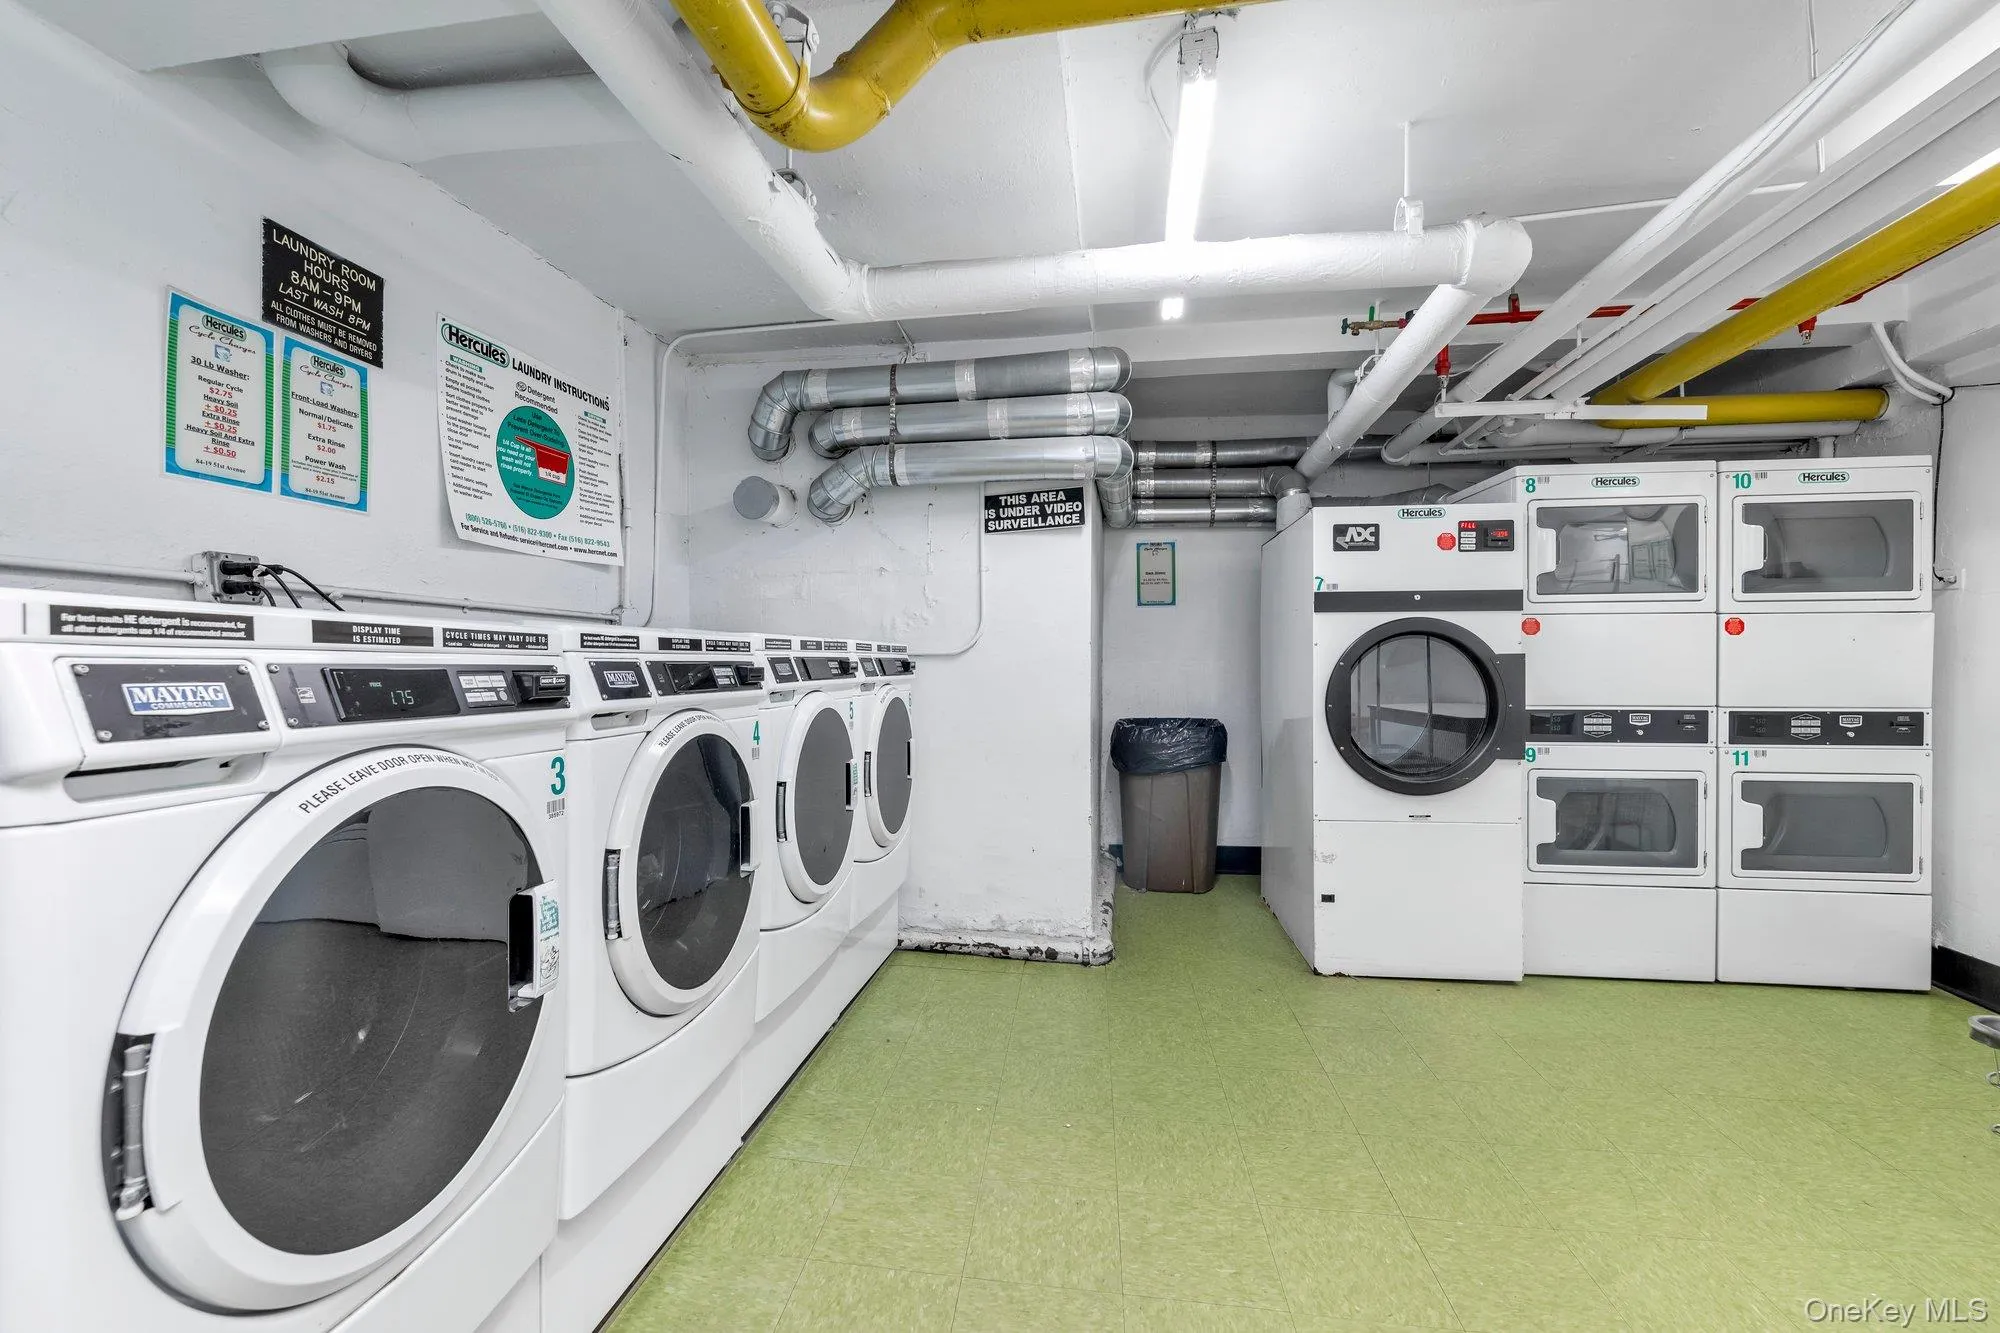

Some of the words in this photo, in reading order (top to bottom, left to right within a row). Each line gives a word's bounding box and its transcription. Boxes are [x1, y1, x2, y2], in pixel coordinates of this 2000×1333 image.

[273, 229, 335, 270] LAUNDRY
[342, 264, 376, 291] ROOM
[304, 260, 349, 292] HOURS
[279, 282, 309, 302] LAST
[314, 298, 343, 318] WASH
[349, 314, 371, 331] 8PM
[205, 316, 243, 338] Hercules
[271, 300, 283, 313] ALL
[286, 307, 315, 326] CLOTHES
[318, 320, 336, 334] MUST
[338, 328, 346, 338] BE
[348, 333, 376, 351] REMOVED
[189, 325, 215, 340] Cycle
[220, 336, 256, 354] Charges
[276, 314, 296, 328] FROM
[299, 322, 331, 344] WASHERS
[334, 337, 347, 349] AND
[350, 342, 372, 359] DRYERS
[448, 325, 506, 365] Hercules
[191, 356, 201, 365] 30
[204, 360, 214, 369] Lb
[217, 365, 249, 380] Washer:
[314, 357, 343, 375] Hercules
[198, 375, 224, 387] Regular
[226, 383, 243, 393] Cycle
[300, 365, 321, 377] Cycle
[324, 374, 353, 388] Charges
[512, 358, 552, 386] LAUNDRY
[554, 377, 610, 411] INSTRUCTIONS
[209, 387, 232, 398] $2.75
[528, 386, 555, 403] Detergent
[204, 394, 224, 404] Heavy
[226, 400, 238, 408] Soil
[292, 392, 328, 408] Front-Load
[330, 405, 359, 418] Washers:
[515, 391, 558, 414] Recommended
[202, 411, 220, 420] Extra
[222, 416, 240, 426] Rinse
[214, 406, 237, 417] $0.25
[299, 408, 353, 429] Normal/Delicate
[186, 424, 207, 434] Heavy
[238, 437, 254, 446] Extra
[214, 422, 237, 433] $0.25
[318, 423, 336, 432] $1.75
[212, 438, 230, 447] Rinse
[308, 434, 325, 443] Extra
[328, 439, 345, 448] Rinse
[214, 447, 236, 458] $0.50
[317, 445, 336, 454] $2.00
[497, 446, 506, 454] you
[507, 449, 518, 457] need
[305, 456, 326, 466] Power
[328, 461, 346, 470] Wash
[316, 476, 334, 484] $2.15
[1595, 477, 1636, 486] Hercules
[1733, 473, 1751, 489] 10
[1803, 473, 1846, 482] Hercules
[1526, 478, 1536, 493] 8
[999, 494, 1027, 506] THIS
[1031, 492, 1066, 503] AREA
[985, 510, 995, 519] IS
[999, 507, 1040, 518] UNDER
[1045, 502, 1082, 513] VIDEO
[1402, 509, 1442, 517] Hercules
[988, 514, 1080, 530] SURVEILLANCE
[461, 523, 469, 531] For
[470, 525, 489, 535] Service
[490, 530, 498, 538] and
[573, 547, 617, 557] www.hercnet.com
[558, 534, 567, 542] Fax
[1345, 527, 1375, 542] ADC
[1315, 577, 1324, 590] 7
[124, 615, 137, 624] HE
[139, 616, 180, 627] detergent
[182, 618, 190, 626] is
[353, 626, 382, 634] DISPLAY
[385, 627, 400, 635] TIME
[446, 631, 467, 639] CYCLE
[363, 636, 400, 644] ESTIMATED
[607, 672, 635, 682] MAYTAG
[131, 685, 224, 703] MAYTAG
[151, 701, 213, 710] COMMERCIAL
[753, 721, 760, 745] 4
[1526, 748, 1536, 762] 9
[1733, 751, 1749, 766] 11
[299, 780, 345, 813] PLEASE
[342, 764, 378, 786] LEAVE
[377, 756, 406, 771] DOOR
[410, 754, 434, 763] OPEN
[433, 755, 460, 765] WHEN
[551, 757, 565, 795] 3
